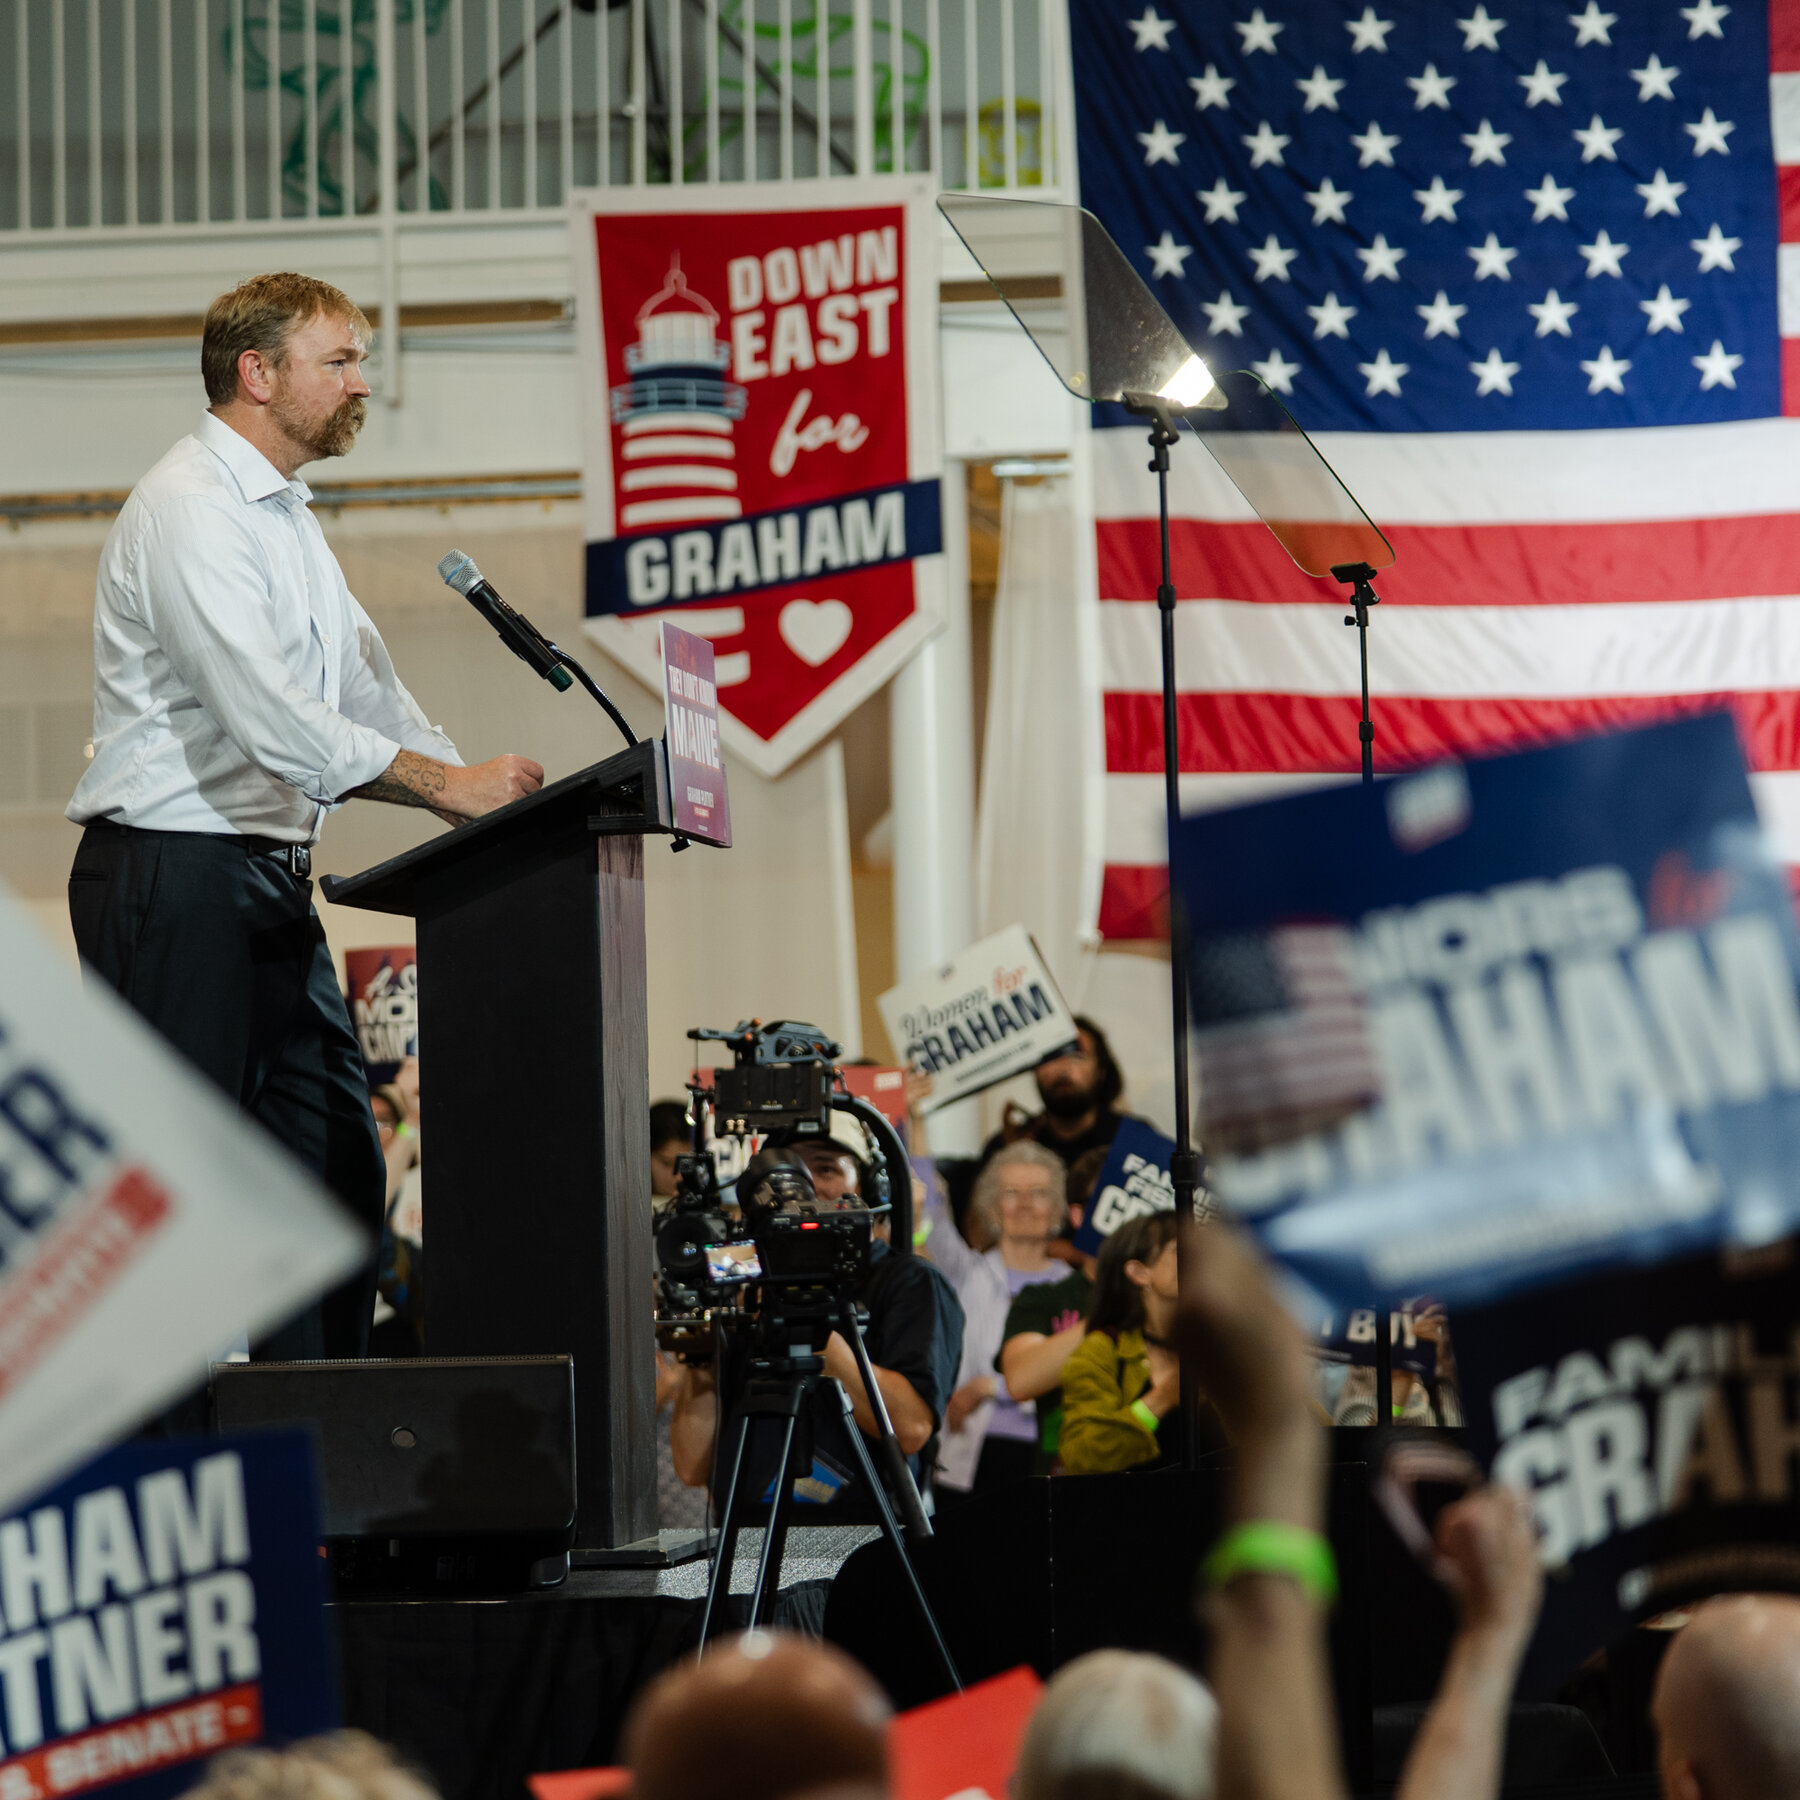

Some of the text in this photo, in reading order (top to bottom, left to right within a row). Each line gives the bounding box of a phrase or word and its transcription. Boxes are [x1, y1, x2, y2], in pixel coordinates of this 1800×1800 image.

[727, 226, 898, 311] DOWN
[732, 288, 898, 383] EAST
[769, 389, 869, 477] for
[625, 491, 907, 606] GRAHAM
[672, 703, 720, 769] MAINE
[907, 983, 1053, 1075] GRAHAM
[0, 1450, 251, 1634] HAM
[0, 1568, 262, 1757] TNER
